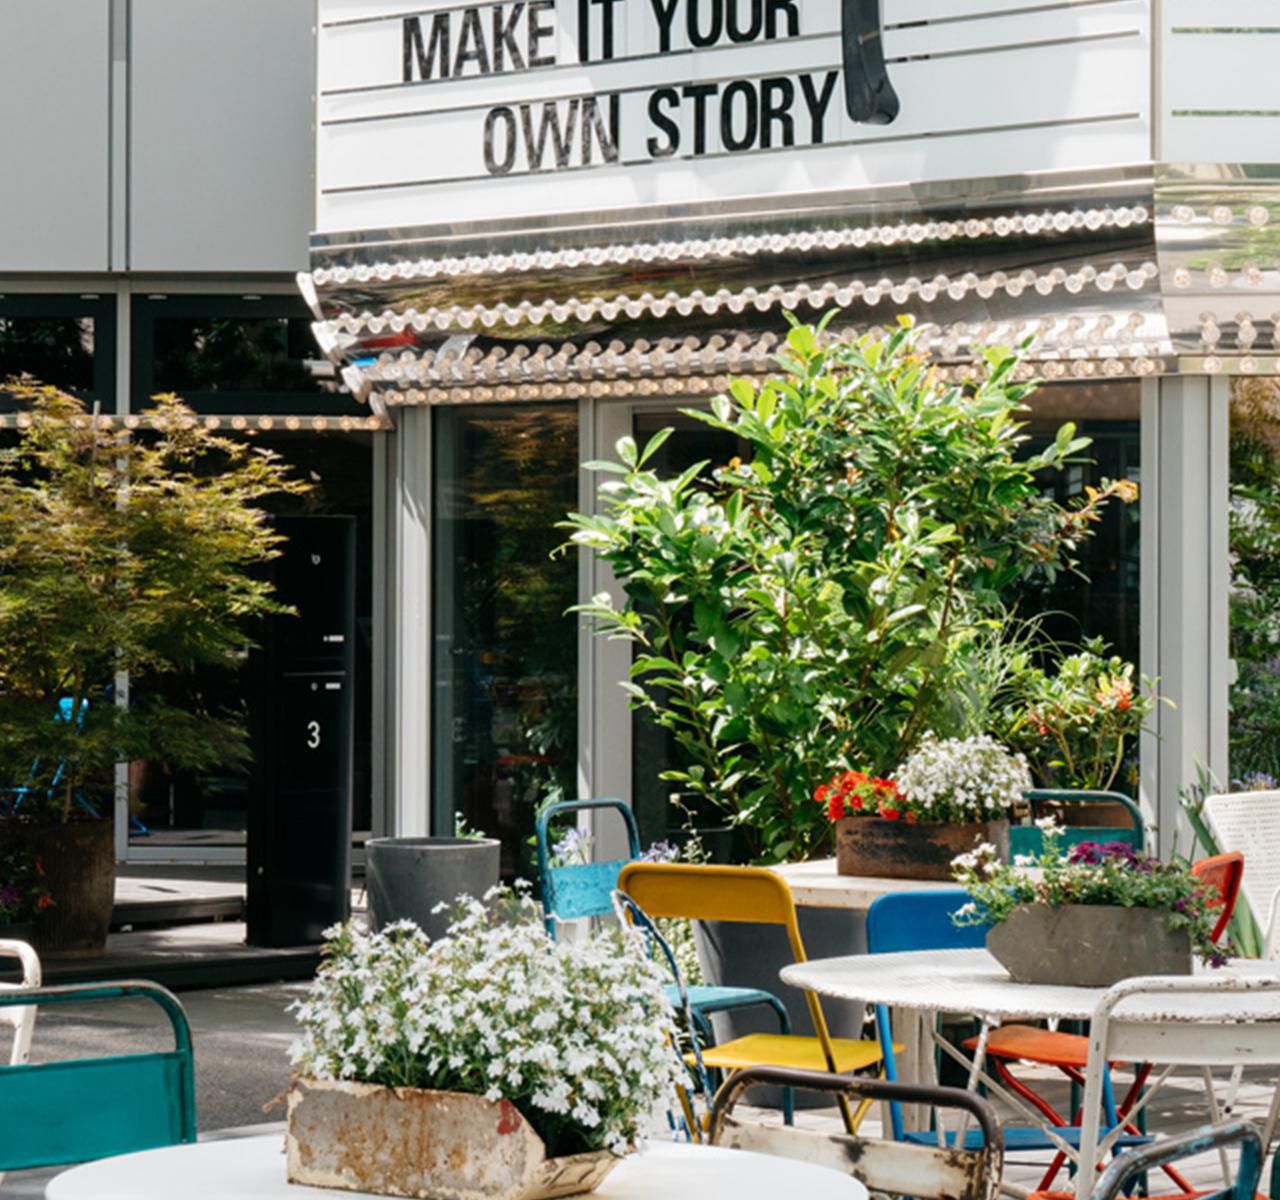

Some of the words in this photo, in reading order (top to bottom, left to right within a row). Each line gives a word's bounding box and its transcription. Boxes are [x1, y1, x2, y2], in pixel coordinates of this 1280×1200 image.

[403, 1, 556, 82] MAKE
[578, 0, 620, 61] IT
[652, 0, 799, 51] YOUR
[483, 94, 619, 175] OWN
[647, 71, 839, 158] STORY
[307, 720, 320, 748] 3
